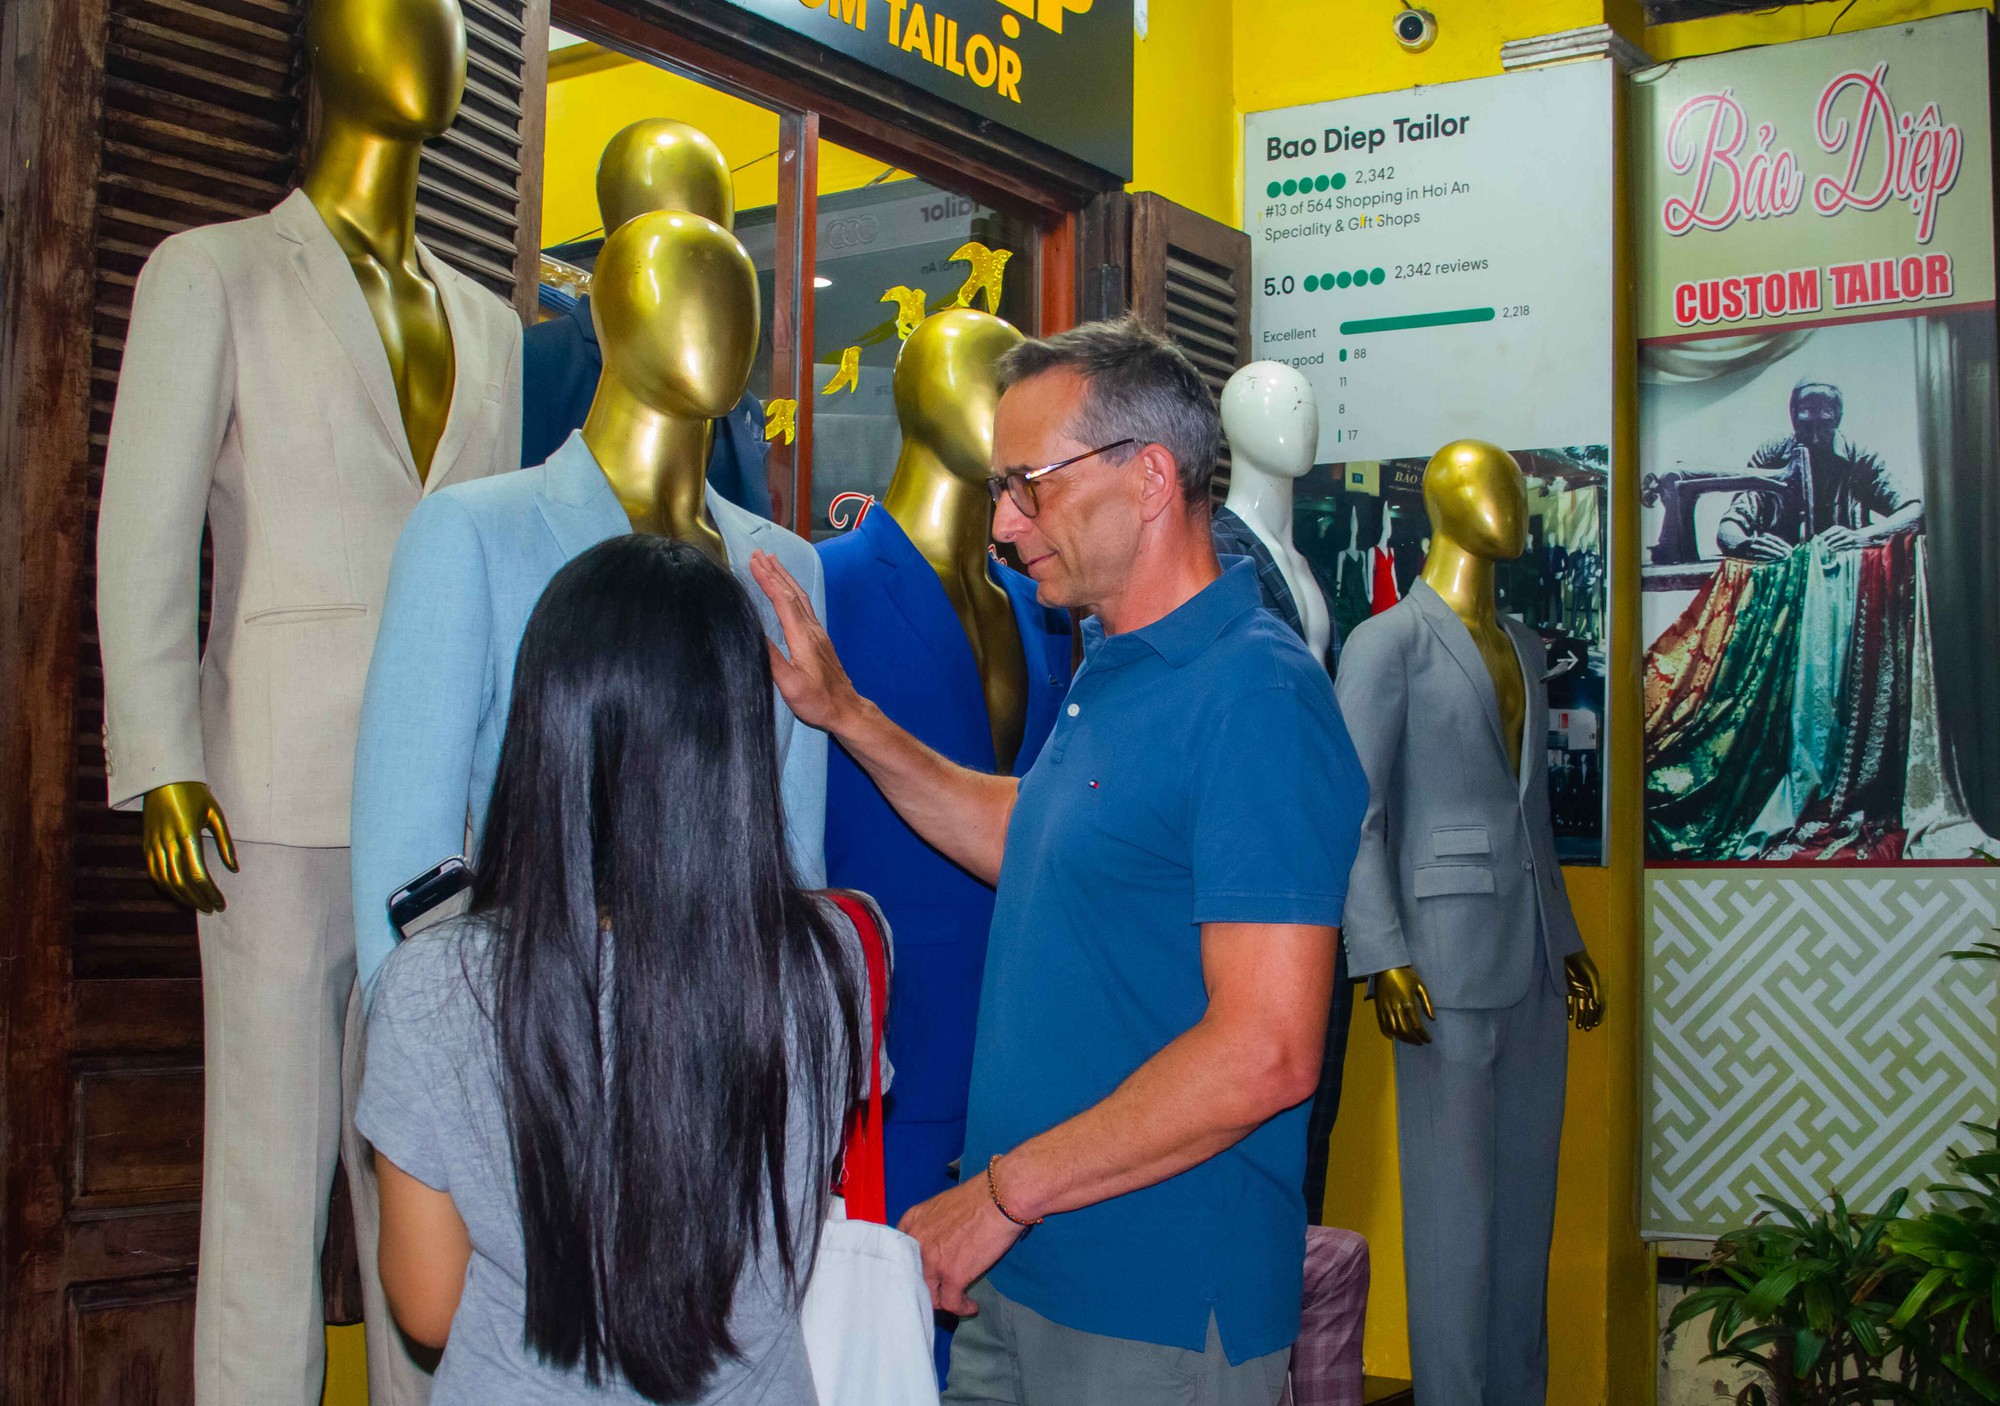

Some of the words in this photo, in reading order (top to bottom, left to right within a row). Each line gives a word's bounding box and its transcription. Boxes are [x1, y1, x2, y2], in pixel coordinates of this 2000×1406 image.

[884, 0, 1022, 104] TAILOR
[1266, 136, 1317, 161] Bao
[1323, 126, 1386, 154] Diep
[1393, 113, 1470, 142] Tailor
[1662, 88, 1803, 236] Bảo
[1811, 60, 1963, 244] Diệp
[1355, 167, 1395, 185] 2,342
[1265, 204, 1288, 218] #13
[1290, 201, 1304, 215] of
[1307, 198, 1332, 213] 564
[1335, 191, 1403, 210] Shopping
[1406, 188, 1419, 201] in
[1422, 183, 1448, 198] Hoi
[1450, 181, 1470, 196] An
[1264, 220, 1332, 243] Speciality
[1335, 219, 1344, 233] &
[1376, 211, 1421, 228] Shops
[1264, 275, 1295, 296] 5.0
[1394, 262, 1432, 281] 2,342
[1435, 258, 1489, 275] reviews
[1674, 267, 1822, 326] CUSTOM
[1828, 252, 1953, 308] TAILOR
[1502, 305, 1530, 319] 2,218
[1263, 328, 1317, 343] Excellent
[1292, 352, 1324, 369] good
[1353, 348, 1367, 359] 88
[1339, 376, 1347, 387] 11
[1338, 403, 1346, 415] 8
[1347, 429, 1358, 441] 17
